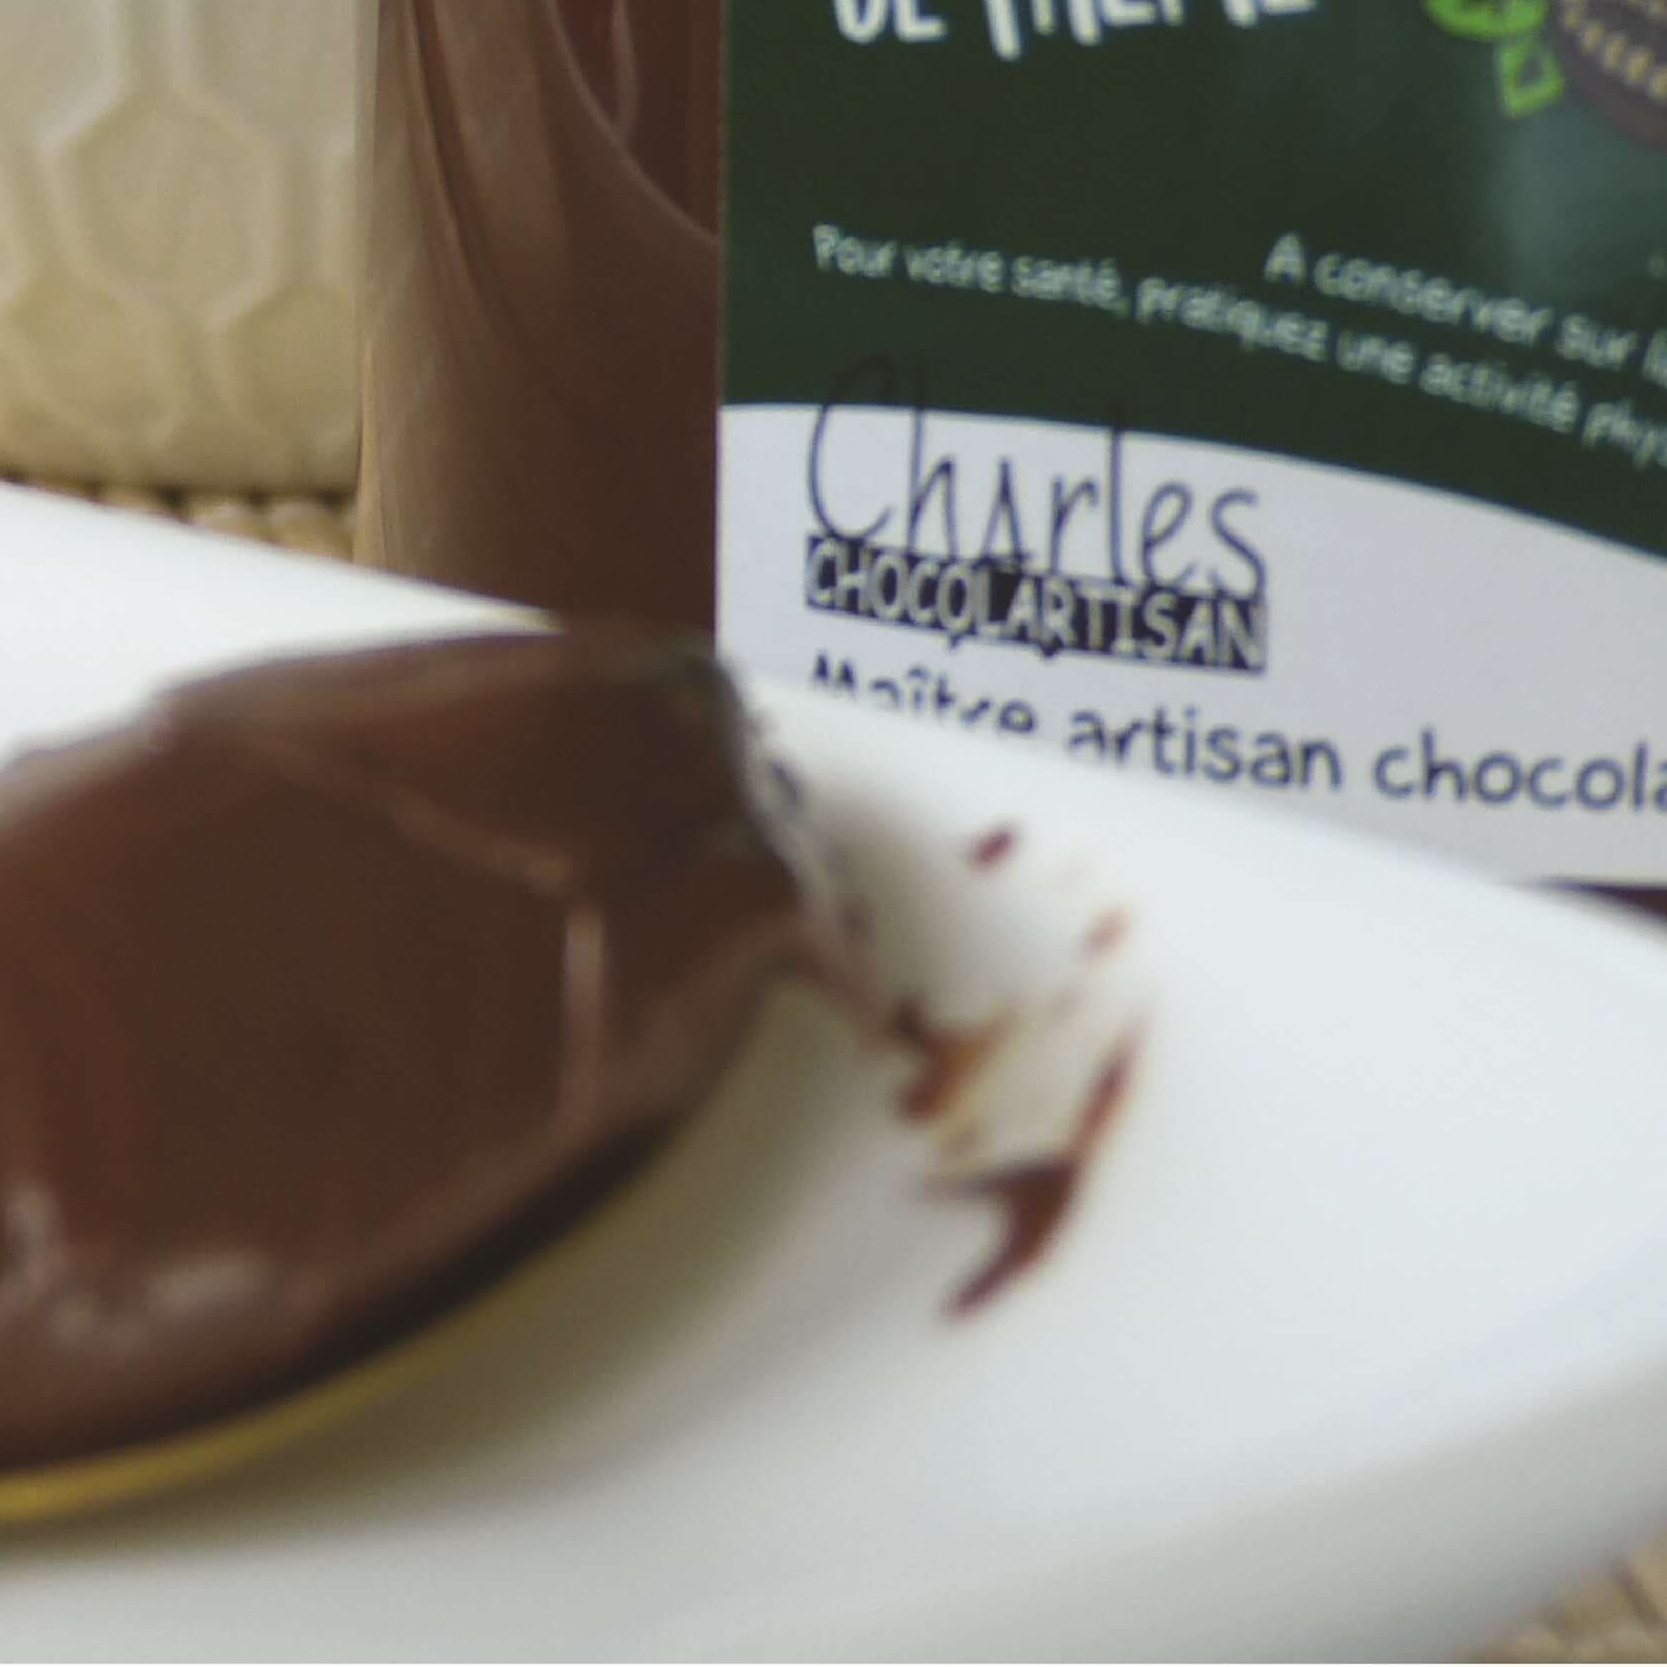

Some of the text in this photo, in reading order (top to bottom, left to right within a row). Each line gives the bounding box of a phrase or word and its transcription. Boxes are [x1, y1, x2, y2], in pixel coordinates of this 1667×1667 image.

[813, 223, 896, 278] Pour
[904, 241, 1005, 293] votre
[1135, 276, 1328, 363] pratiquez
[1336, 332, 1415, 384] une
[1419, 351, 1579, 433] activité
[1313, 252, 1554, 346] conserver
[1068, 703, 1344, 791] artisan
